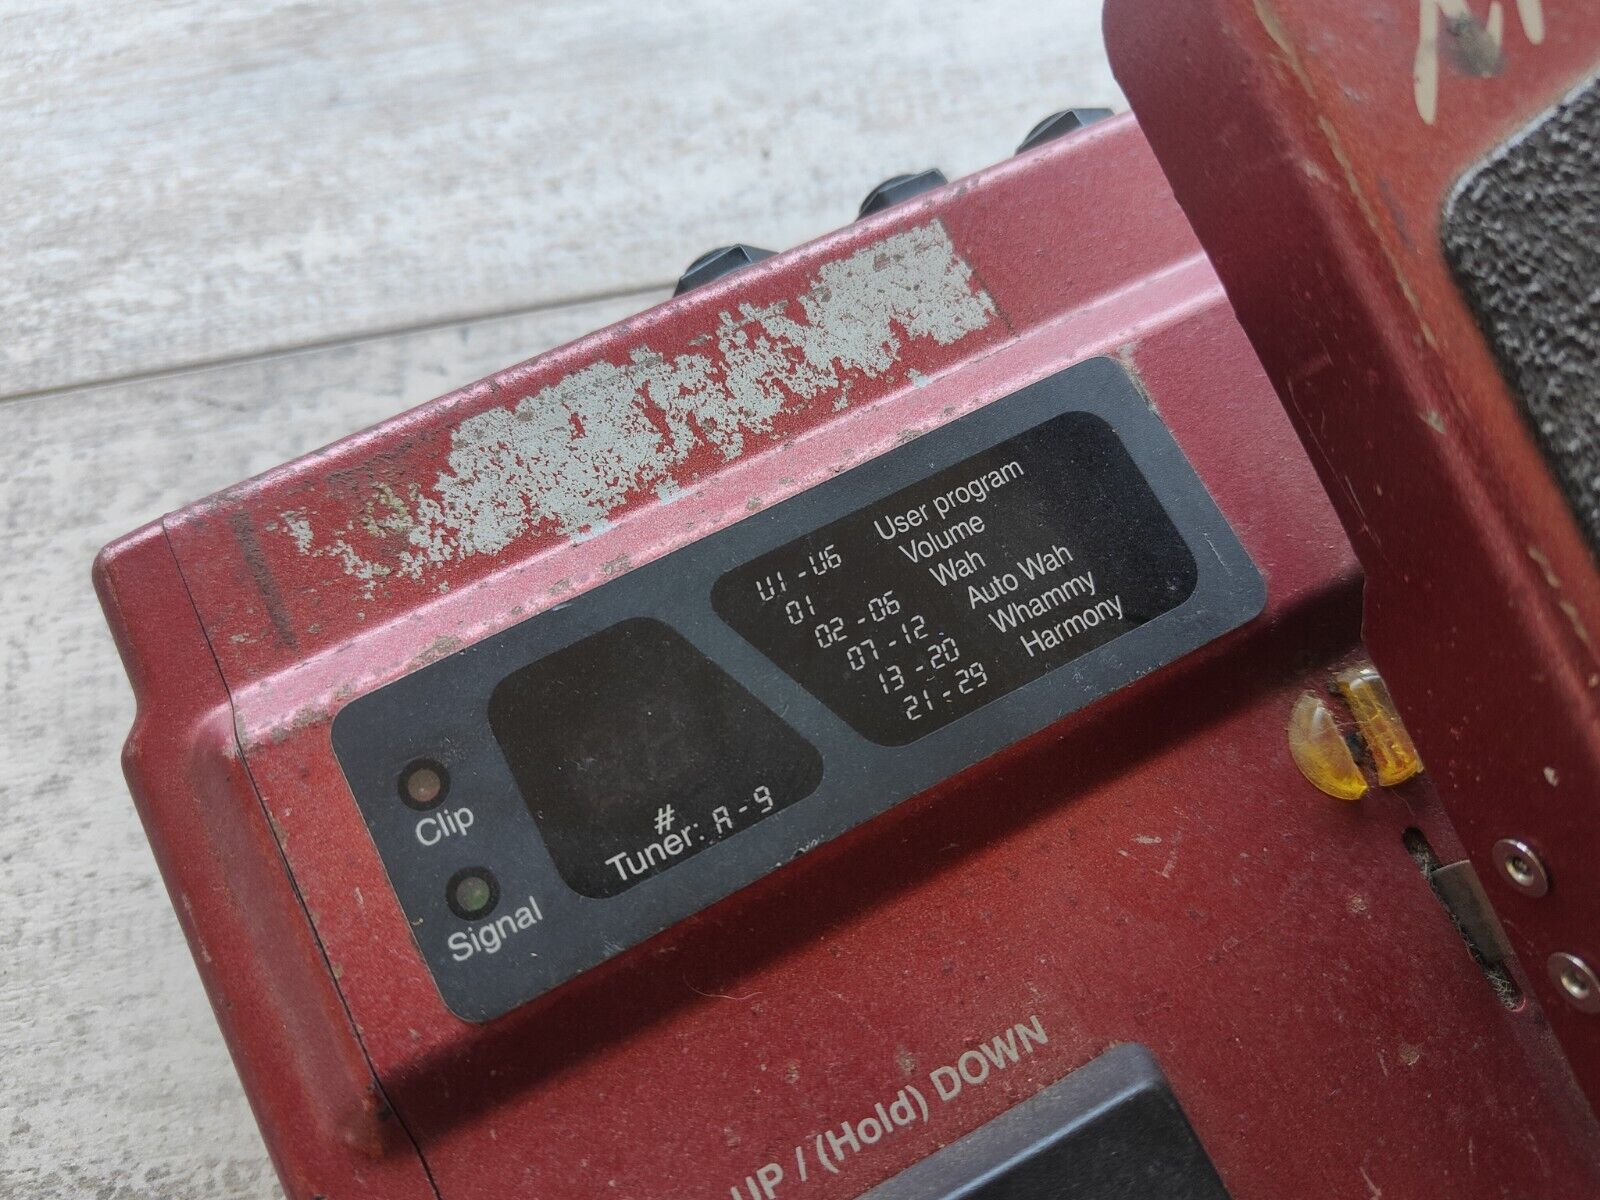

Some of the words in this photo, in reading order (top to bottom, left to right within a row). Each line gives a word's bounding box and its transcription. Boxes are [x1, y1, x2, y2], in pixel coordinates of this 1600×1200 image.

[874, 504, 928, 540] User
[933, 461, 1024, 519] program
[898, 516, 985, 563] Volume
[929, 551, 986, 586] Wah
[968, 574, 1018, 609] Auto
[1017, 545, 1073, 580] Wah
[988, 571, 1095, 632] Whammy
[1020, 595, 1123, 657] Harmony
[416, 808, 473, 845] Clip
[605, 823, 704, 880] Tuner:
[448, 896, 542, 961] Signal
[795, 1145, 808, 1182] /
[815, 1084, 929, 1174] (Hold)
[929, 1014, 1049, 1102] DOWN
